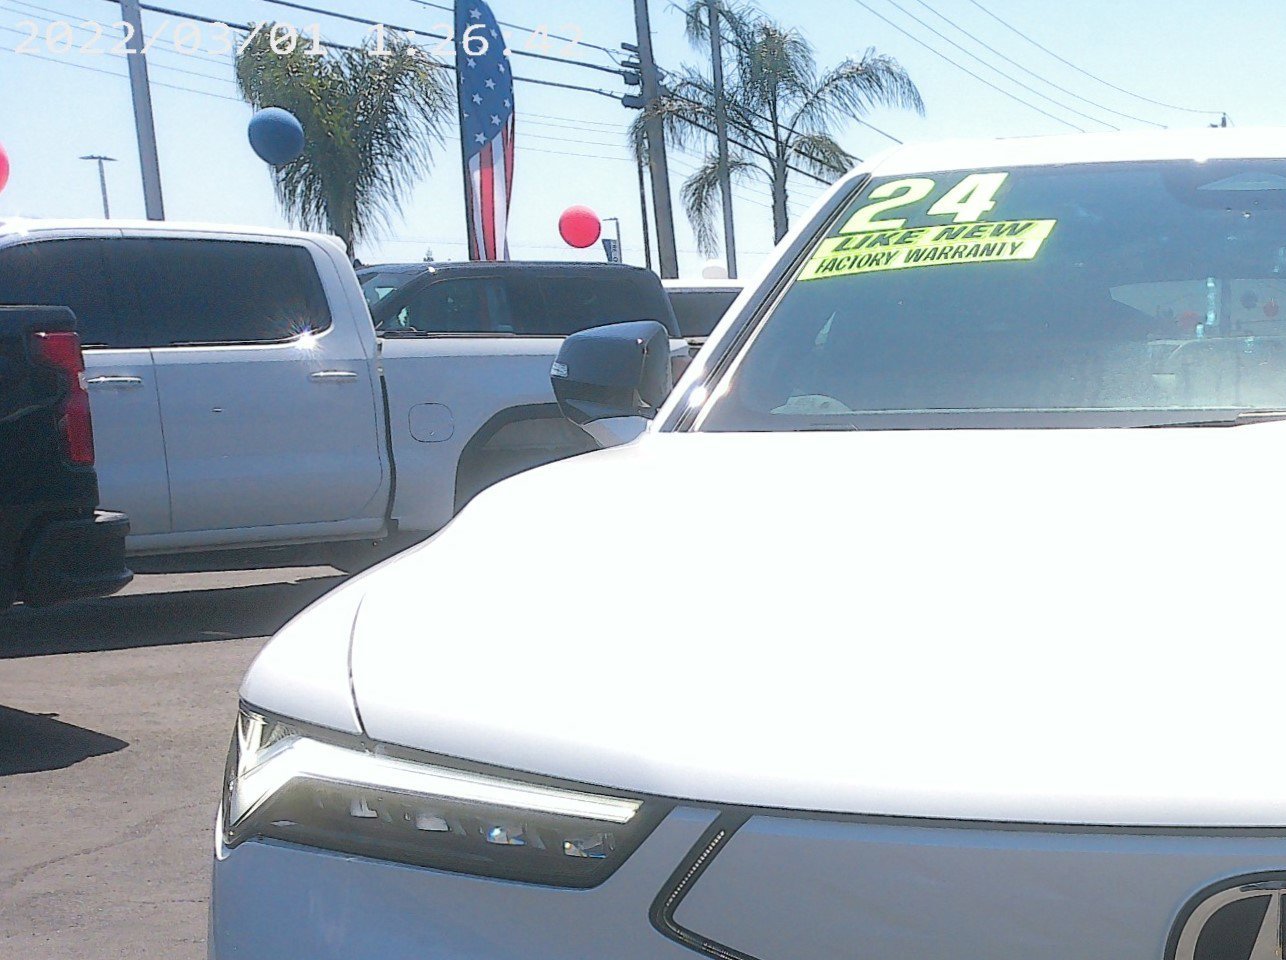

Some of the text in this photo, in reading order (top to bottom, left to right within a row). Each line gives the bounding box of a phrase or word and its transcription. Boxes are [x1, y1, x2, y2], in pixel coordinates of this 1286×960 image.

[838, 172, 1009, 234] 24
[831, 221, 1034, 252] LIKE NEW
[814, 241, 1024, 274] FACTORY WARRANTY
